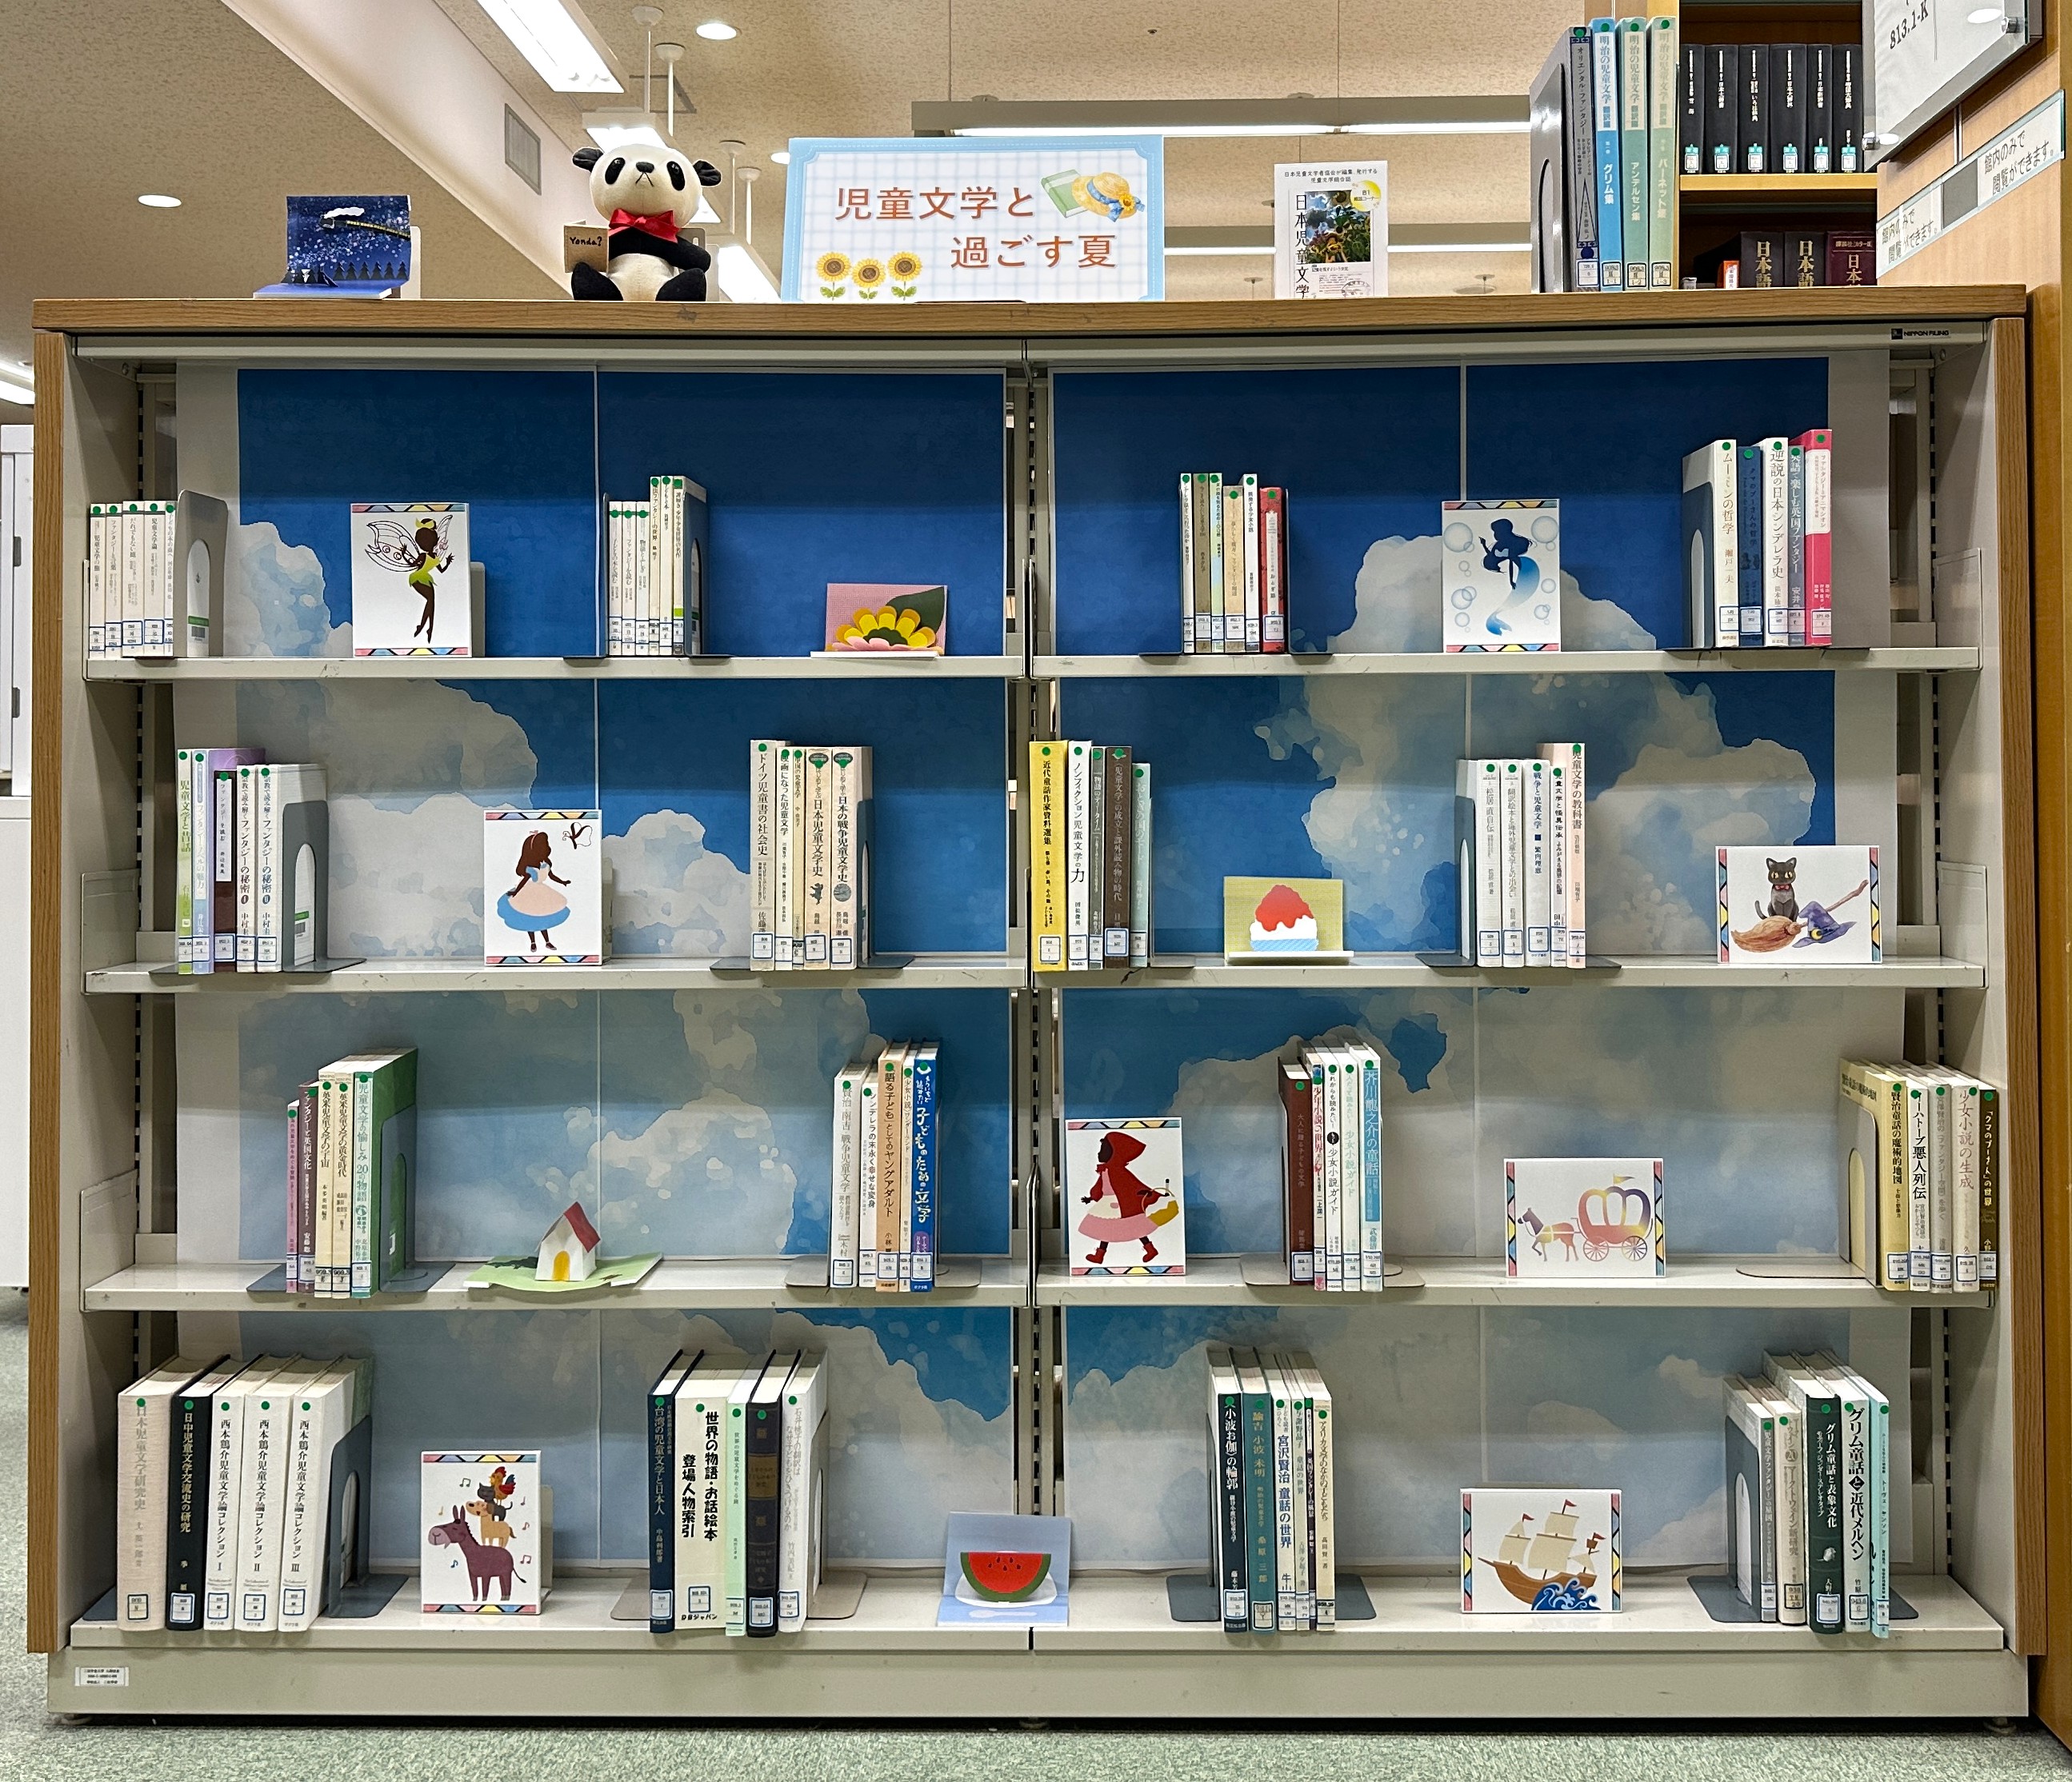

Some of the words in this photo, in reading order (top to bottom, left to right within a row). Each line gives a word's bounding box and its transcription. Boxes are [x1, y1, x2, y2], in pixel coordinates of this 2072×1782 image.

[1890, 1, 1929, 49] 813.1-K
[1599, 35, 1611, 104] 明治の児童文学
[1629, 35, 1640, 104] 明治の児童文学
[1658, 33, 1670, 102] 明治の児童文学
[1603, 162, 1614, 205] グリム集
[1630, 162, 1641, 221] アンデルセン集
[1657, 159, 1668, 219] バーネット集
[1984, 130, 2026, 174] 館内のみで
[1992, 140, 2054, 195] 閲覧ができます。
[569, 235, 603, 247] Yonda?
[835, 186, 1034, 221] 児童文学と
[950, 234, 1118, 269] 過ごす夏
[1294, 194, 1310, 299] 日本児童文学
[1846, 254, 1863, 286] 日本
[1722, 453, 1734, 534] ムーミンの哲学
[1770, 449, 1785, 579] 逆説の日本シンデレラ史
[180, 780, 191, 853] 児童文学と昔話
[757, 753, 768, 857] ドイツ児童書の社会史
[1042, 760, 1052, 845] 近代童話作家資料選集
[1070, 762, 1085, 884] ノンフィクション児童文学の力
[1572, 750, 1582, 830] 児童文学の教科書
[813, 799, 824, 877] 日本児童文学史
[837, 796, 848, 884] 日本の戦争児童文学史
[1345, 1129, 1356, 1198] 少女小説ガイド
[1364, 1070, 1379, 1177] 芥川龍之介の童話
[1891, 1091, 1902, 1185] 賢治童話の魔術的地図
[1912, 1093, 1926, 1200] イーハトーブ悪人列伝
[1958, 1090, 1974, 1189] 少女小説の生成
[1983, 1110, 1993, 1206] 「クマのプーさん」の世界
[1328, 1147, 1340, 1216] 少女小説ガイド
[134, 1405, 147, 1510] 日本児童文学研究史
[180, 1412, 194, 1533] 日中児童文学交流史の研究
[654, 1405, 666, 1514] 台湾の児童文学と日本人
[682, 1453, 696, 1536] 登場人物索引
[703, 1410, 718, 1540] 世界の物語・お話絵本
[1278, 1435, 1290, 1484] 宮沢賢治
[1826, 1423, 1838, 1528] グリム童話と表象文化
[1849, 1408, 1866, 1560] グリム童話と近代メルヘン
[1278, 1488, 1292, 1549] 童話の世界
